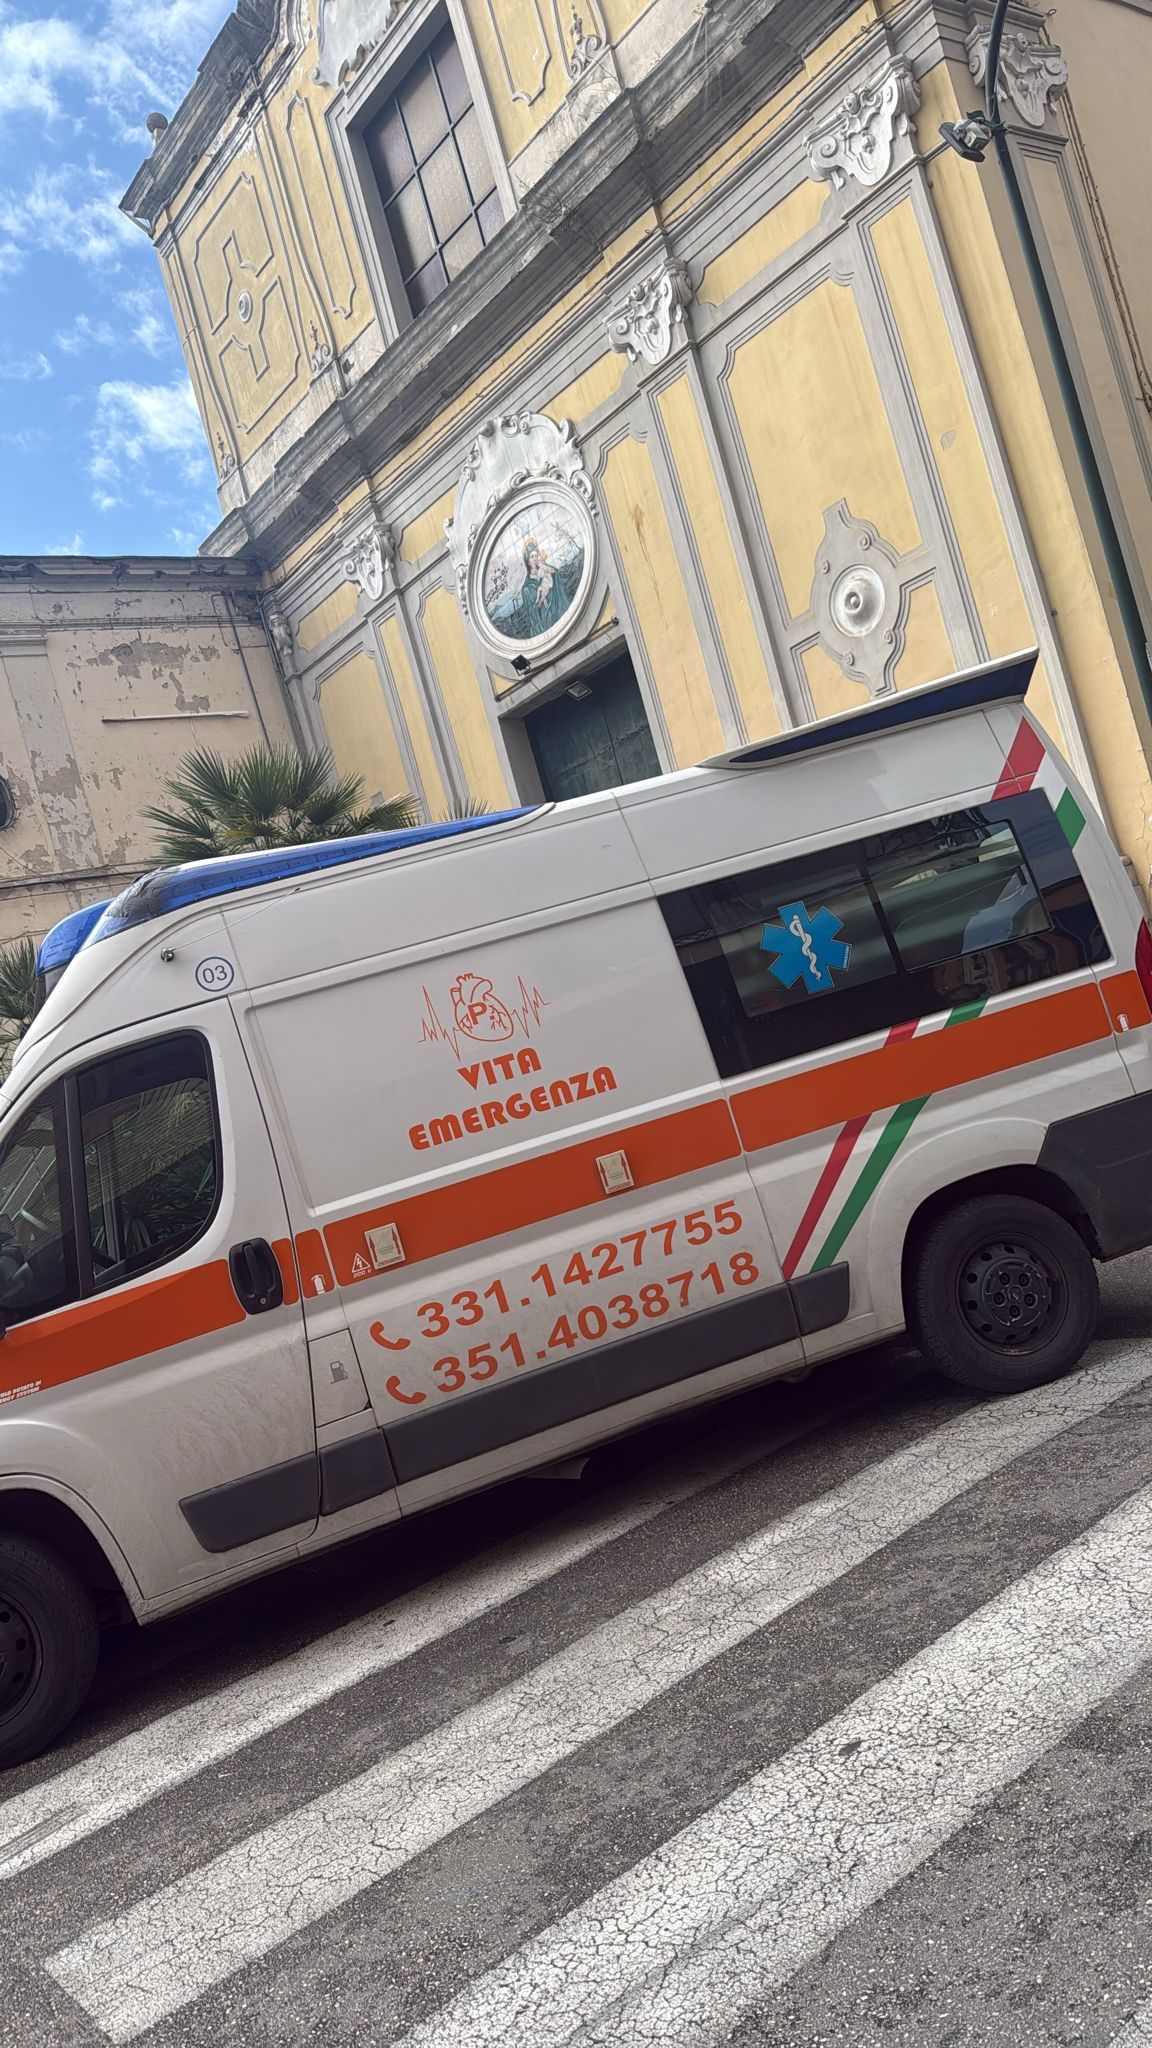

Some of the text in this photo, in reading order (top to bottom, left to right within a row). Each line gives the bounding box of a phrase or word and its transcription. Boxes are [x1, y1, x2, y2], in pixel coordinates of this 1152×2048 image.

[202, 965, 227, 984] 03
[409, 1066, 617, 1151] EMERGENZA
[457, 1047, 542, 1090] VITA
[417, 1199, 742, 1338] 331.1427755
[433, 1252, 760, 1393] 351.4038718
